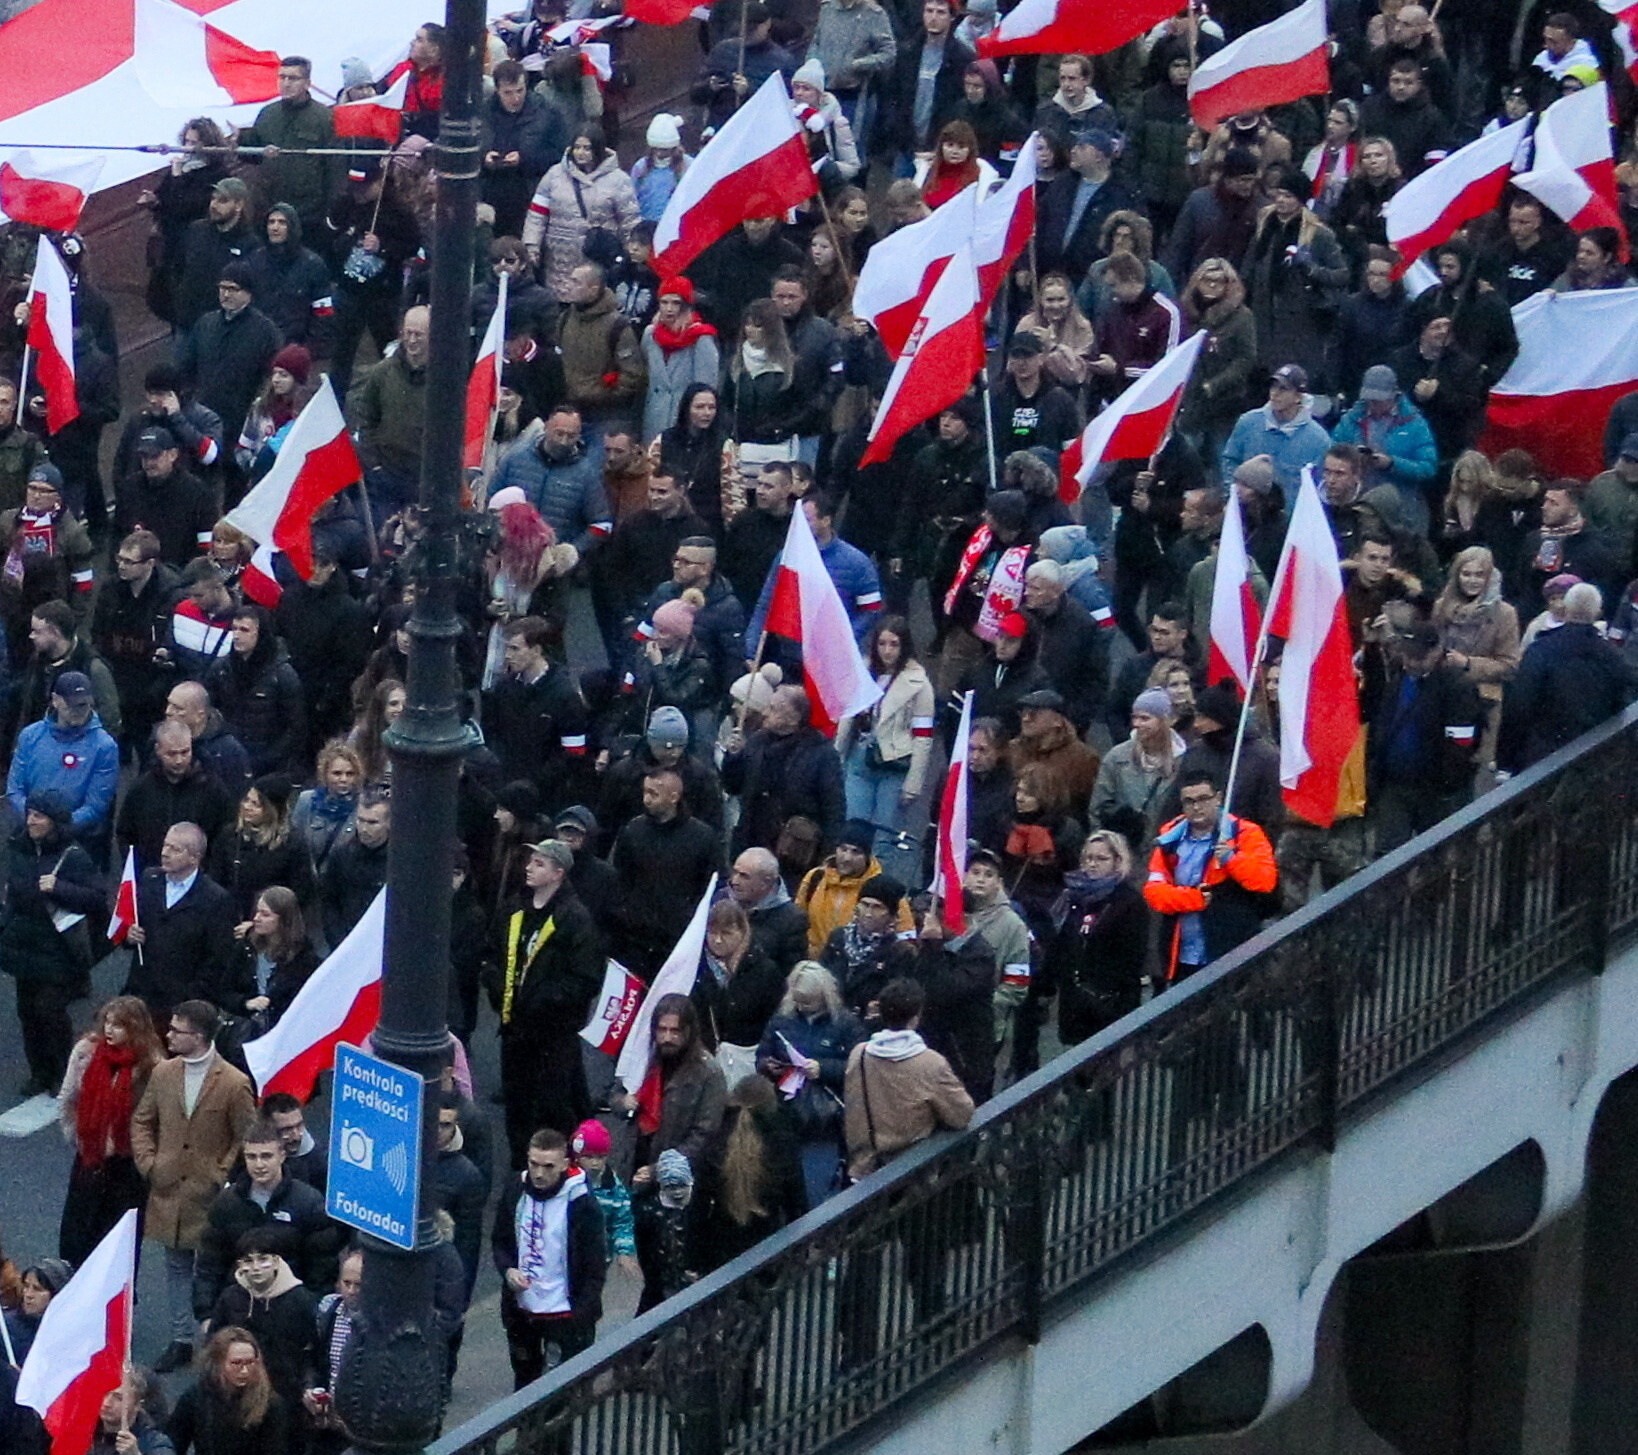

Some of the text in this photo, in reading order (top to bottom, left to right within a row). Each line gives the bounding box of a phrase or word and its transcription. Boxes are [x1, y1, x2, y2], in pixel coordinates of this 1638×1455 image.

[343, 1056, 404, 1098] Kontrola
[342, 1084, 409, 1122] prędkości
[336, 1191, 405, 1237] Fotoradar
